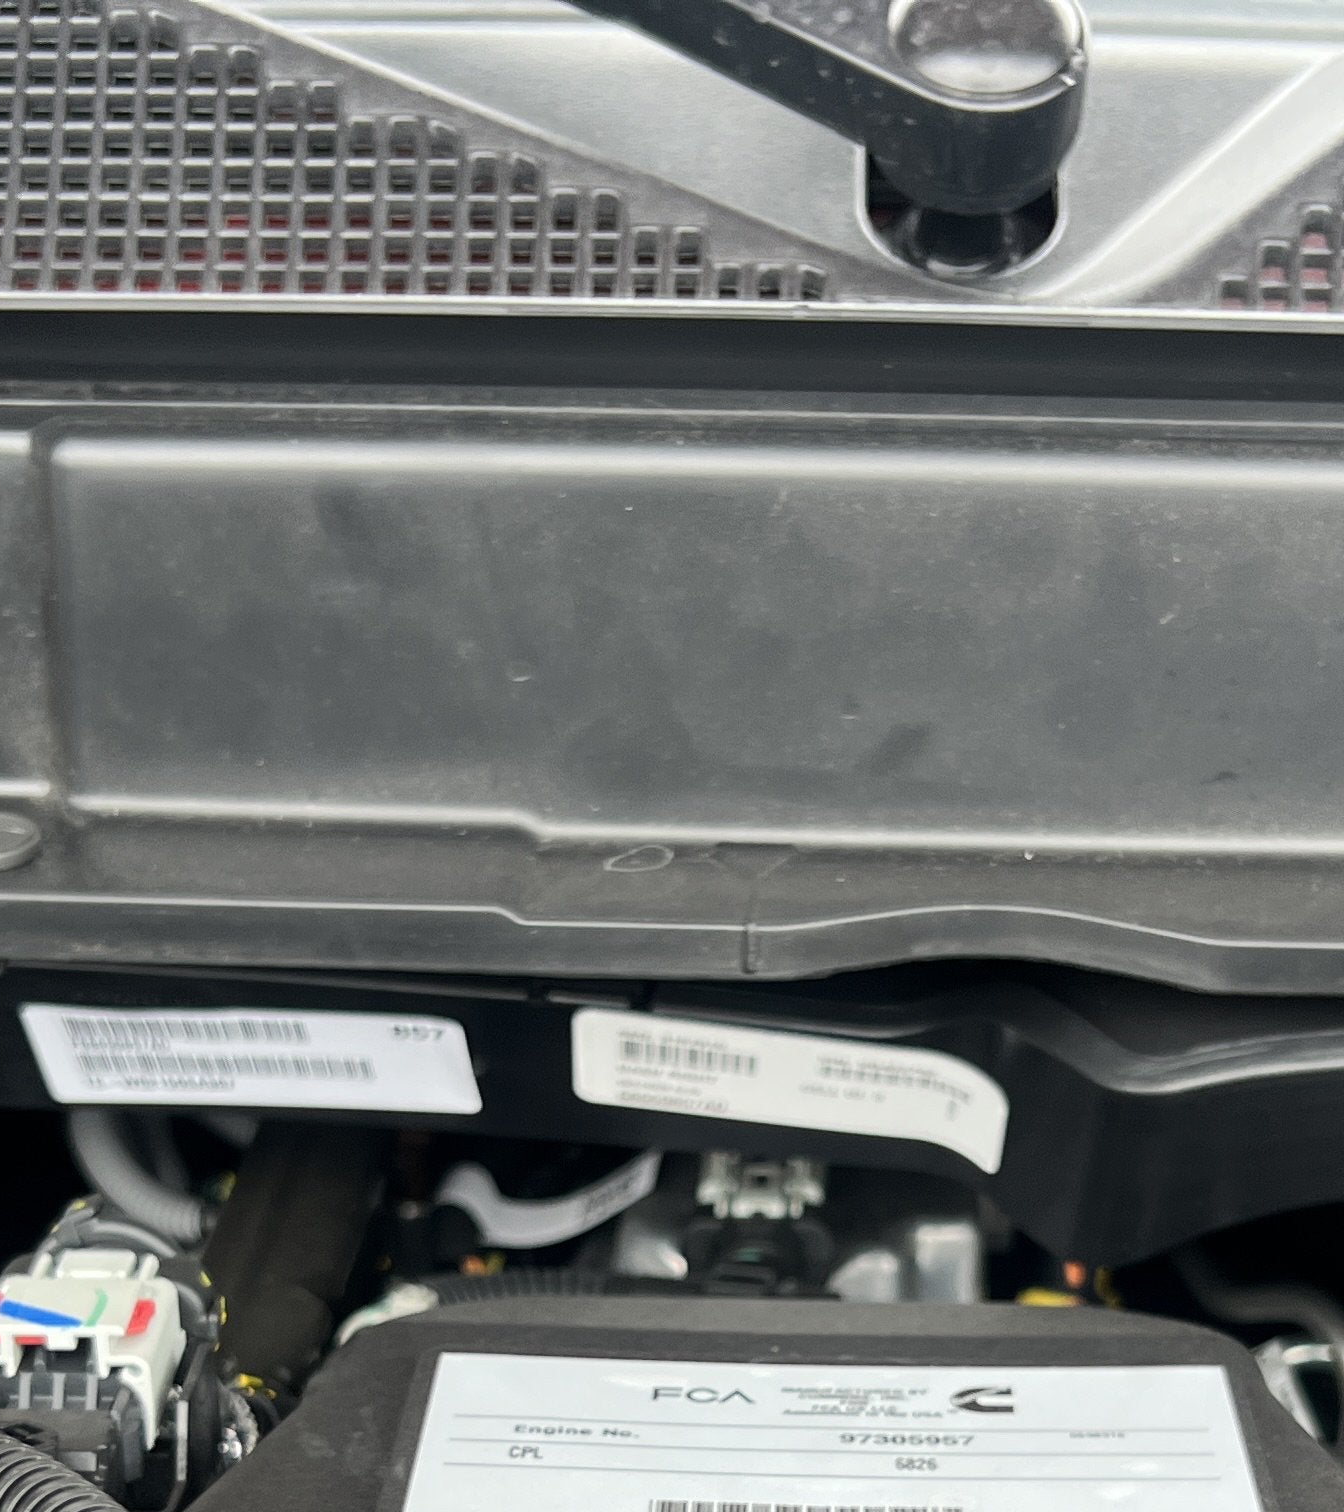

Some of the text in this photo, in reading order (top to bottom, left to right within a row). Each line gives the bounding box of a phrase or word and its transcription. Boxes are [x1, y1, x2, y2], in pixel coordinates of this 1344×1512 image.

[652, 1386, 756, 1404] FCA
[514, 1424, 592, 1436] Engine
[602, 1427, 640, 1439] No.
[509, 1446, 544, 1459] CPL
